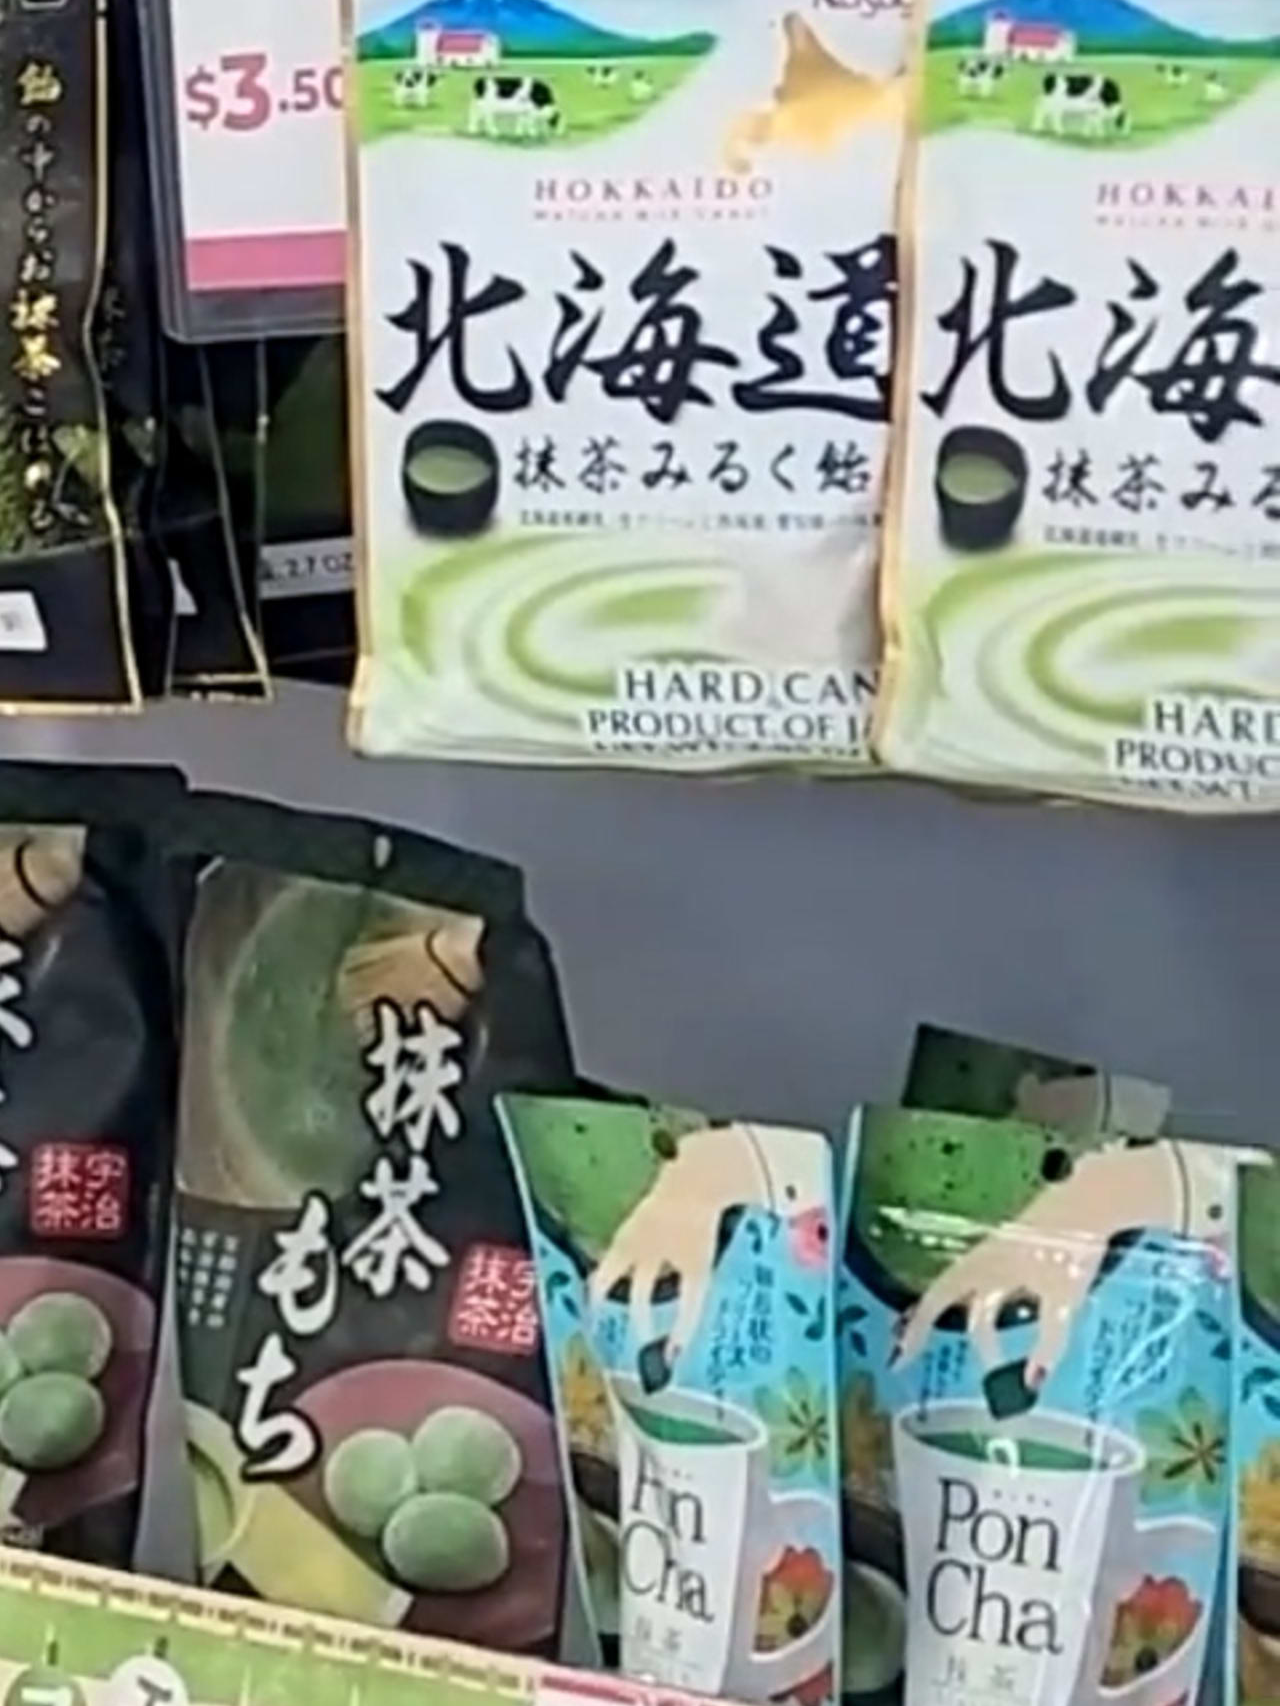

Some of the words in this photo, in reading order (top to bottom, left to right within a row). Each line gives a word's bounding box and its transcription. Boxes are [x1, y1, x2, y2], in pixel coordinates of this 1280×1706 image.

[185, 53, 348, 133] $3.50
[535, 178, 773, 202] HOKKAIDO
[376, 234, 900, 424] 北海道
[514, 436, 874, 494] 抹茶みるく飴
[588, 708, 764, 742] PRODUCT
[625, 667, 764, 703] HARD
[342, 1005, 465, 1297] 抹茶
[239, 1196, 341, 1475] もち
[937, 1477, 1064, 1574] Pon
[926, 1559, 1065, 1659] Cha
